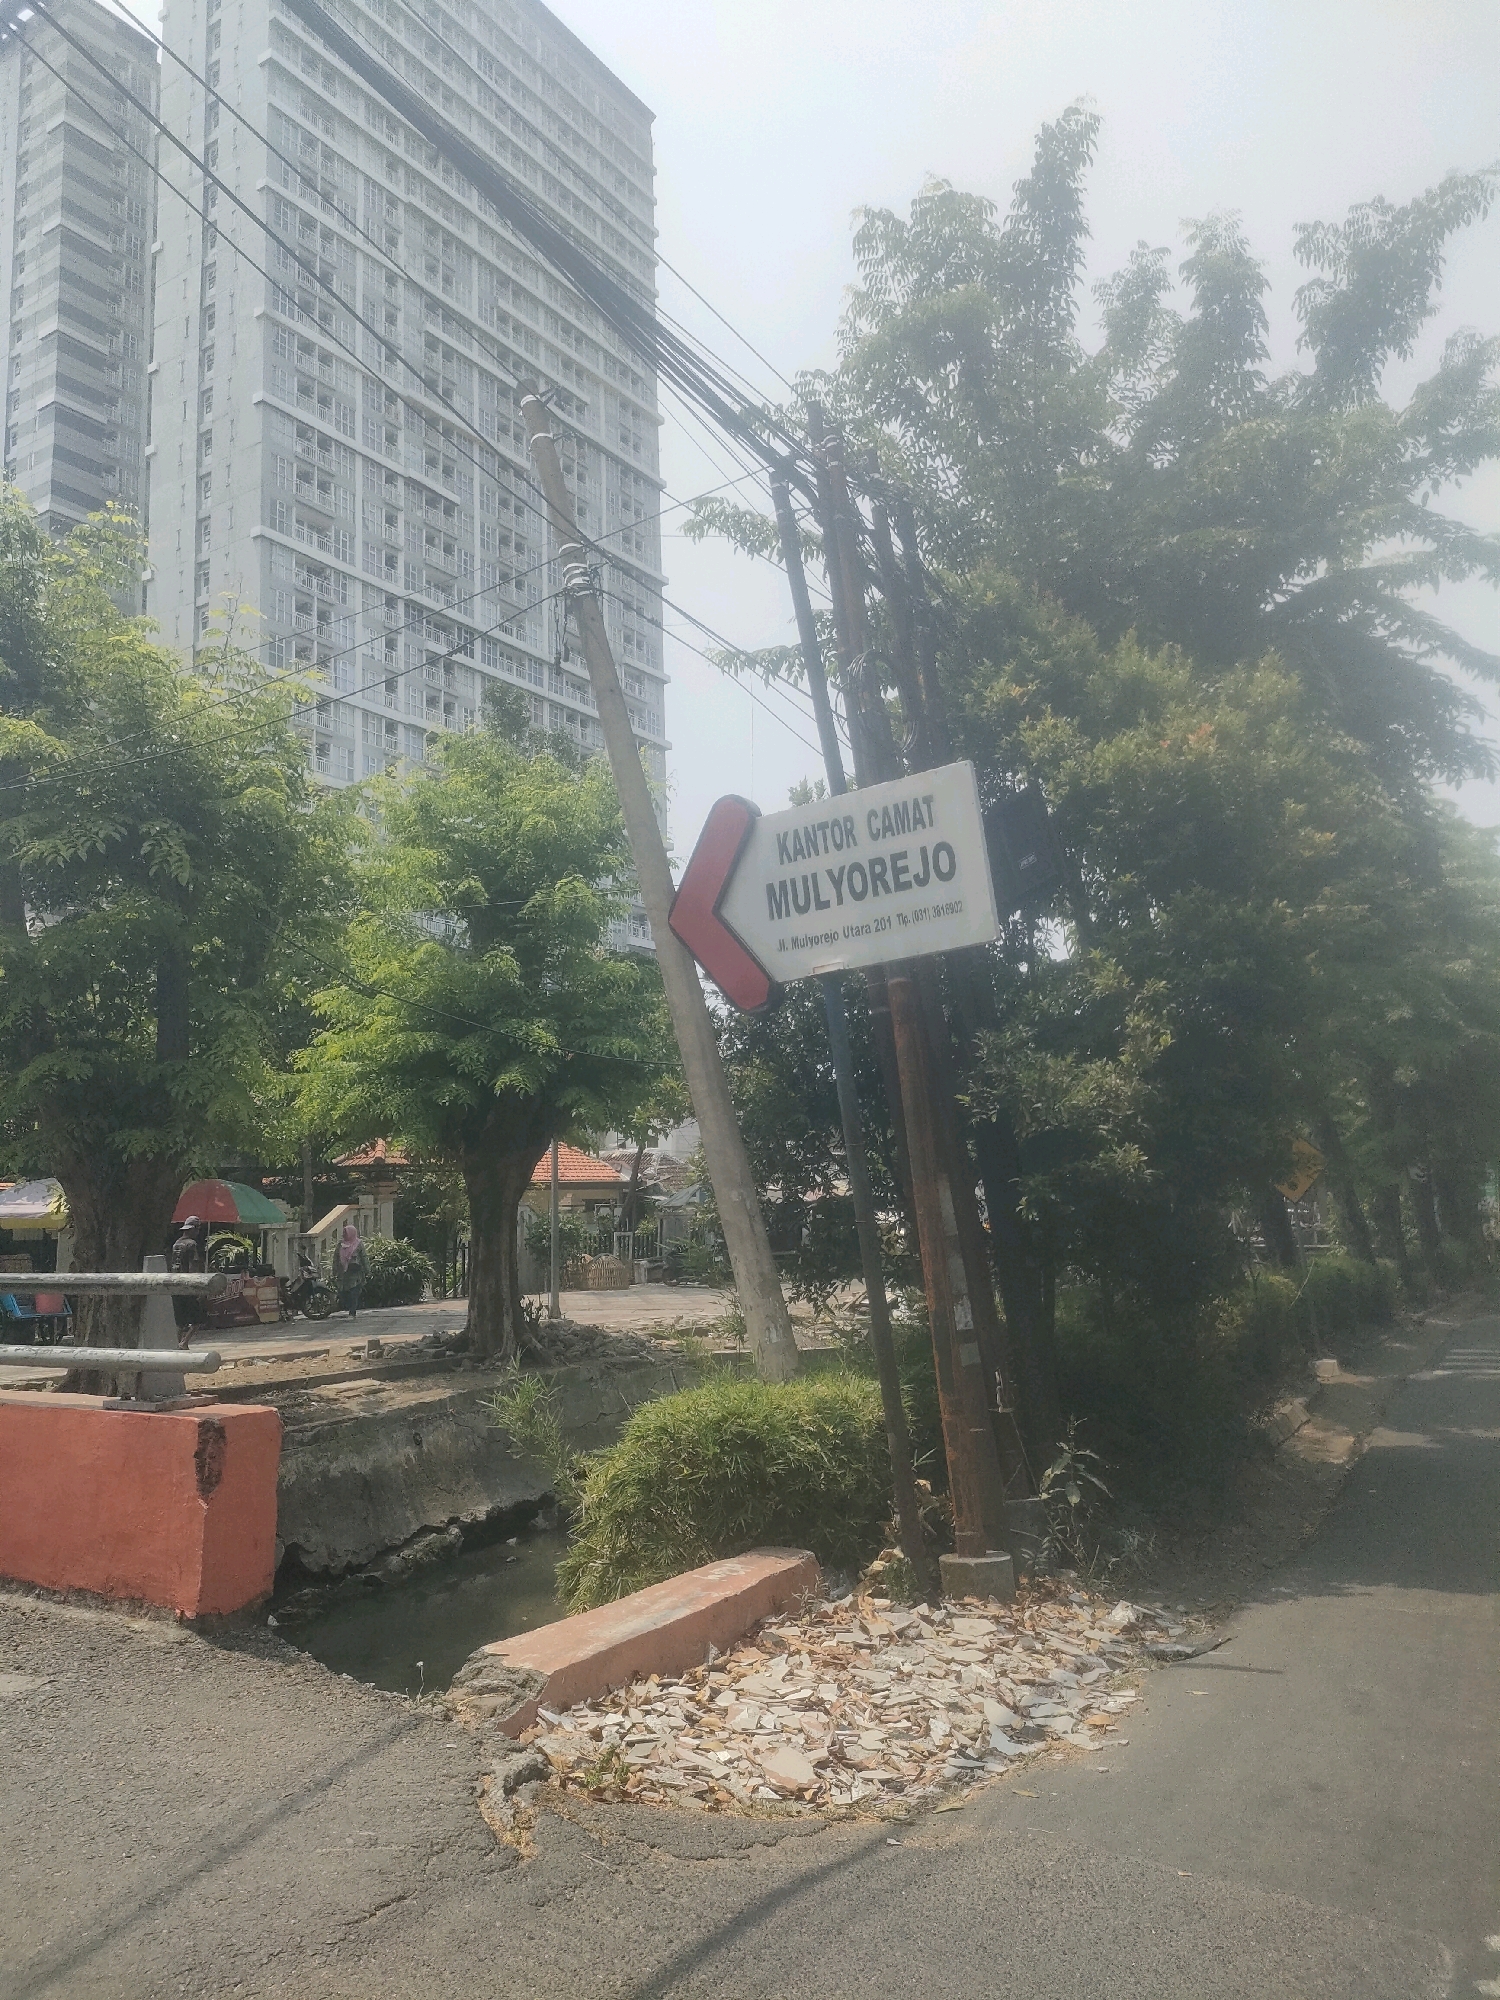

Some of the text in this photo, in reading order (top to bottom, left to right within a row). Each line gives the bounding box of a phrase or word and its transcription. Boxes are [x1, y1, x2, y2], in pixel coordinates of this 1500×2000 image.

[776, 794, 934, 865] KANTOR CAMAT
[765, 841, 957, 921] MULYOREJO
[778, 938, 789, 952] Jl.
[791, 930, 839, 949] Mulyorejo
[842, 924, 872, 939] Utara
[874, 915, 892, 932] 201
[896, 912, 911, 927] Tlp.
[911, 907, 931, 925] (031)
